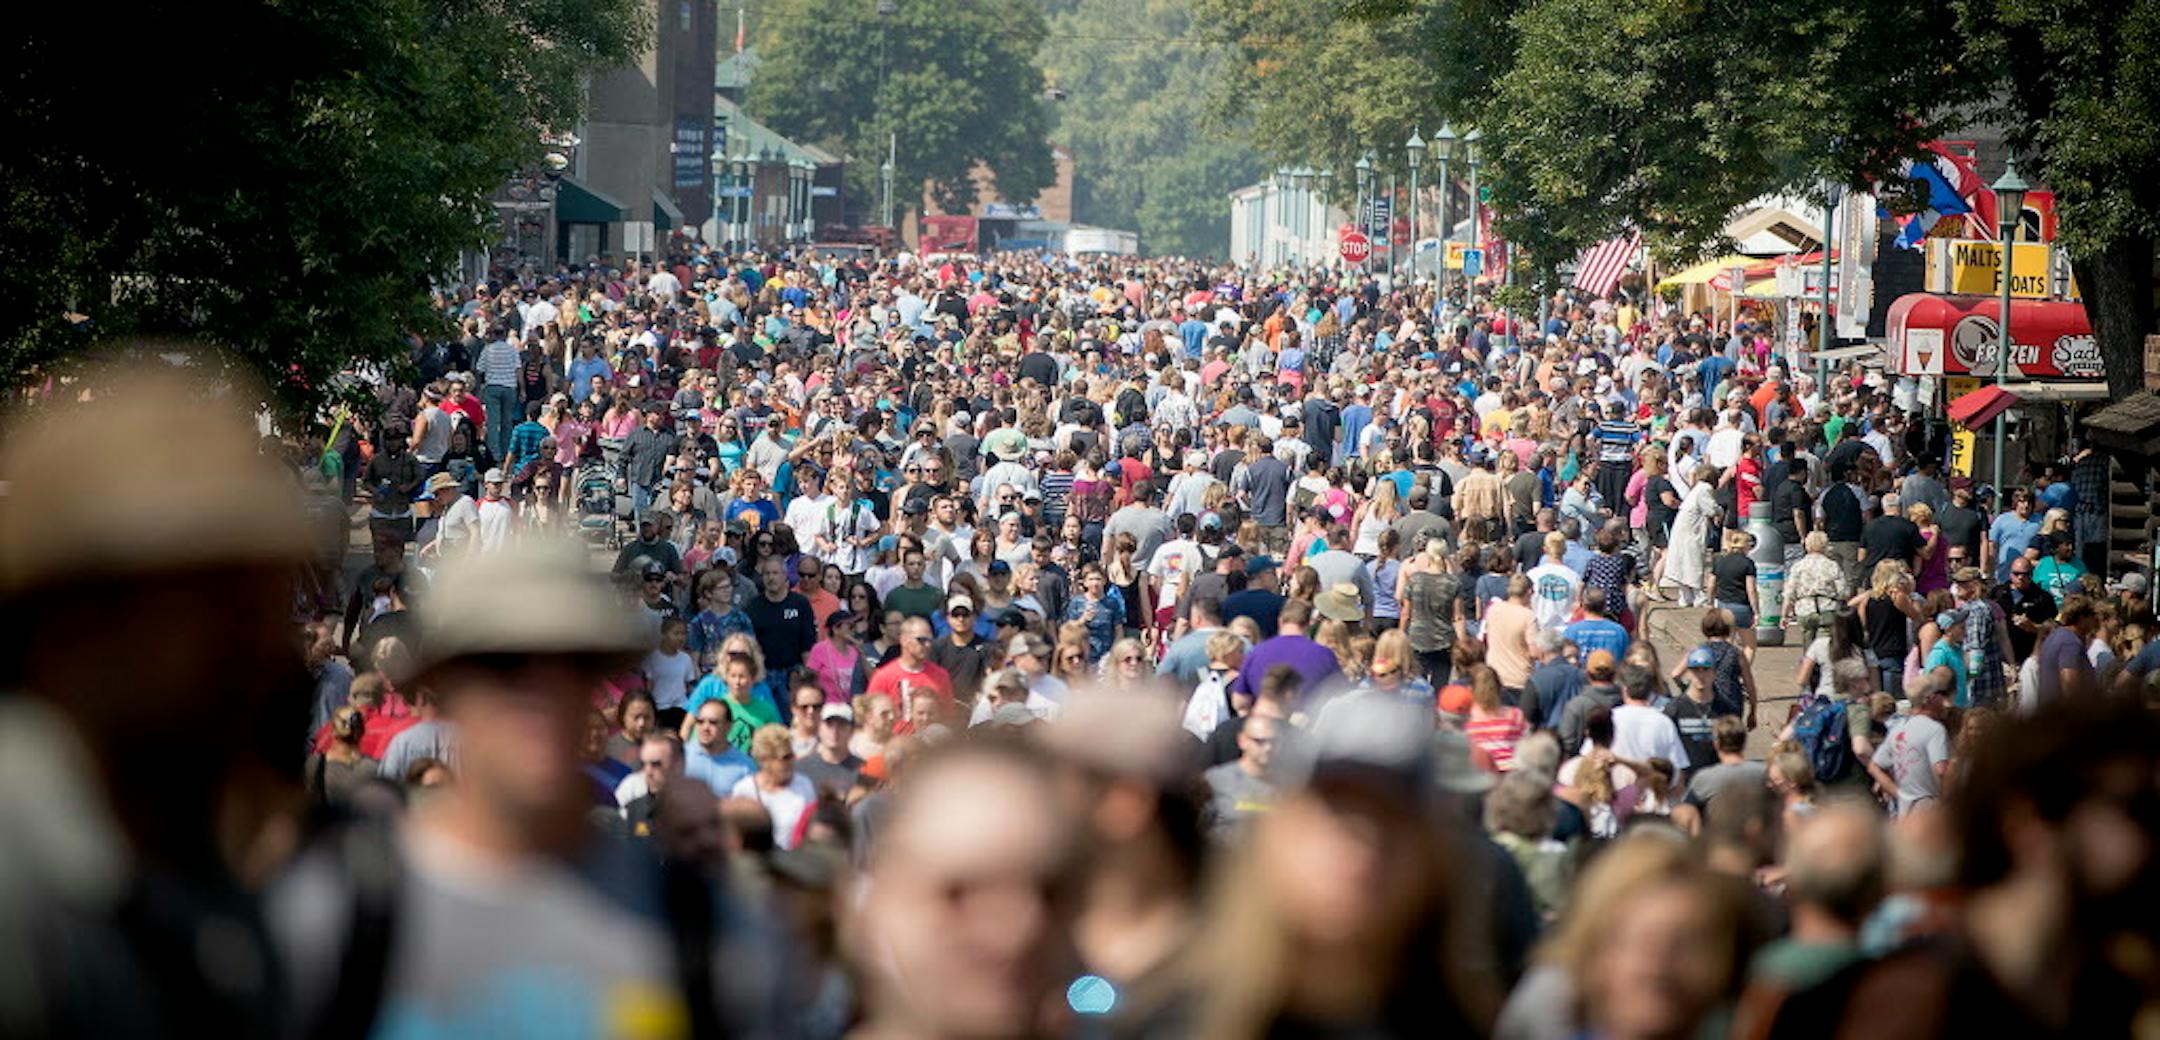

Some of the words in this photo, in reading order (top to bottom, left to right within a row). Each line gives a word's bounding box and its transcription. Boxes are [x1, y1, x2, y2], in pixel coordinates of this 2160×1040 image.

[1342, 241, 1368, 256] STOP
[1956, 245, 2002, 268] MALTS
[1994, 271, 2045, 293] FOATS
[1974, 343, 2041, 364] FRZEN
